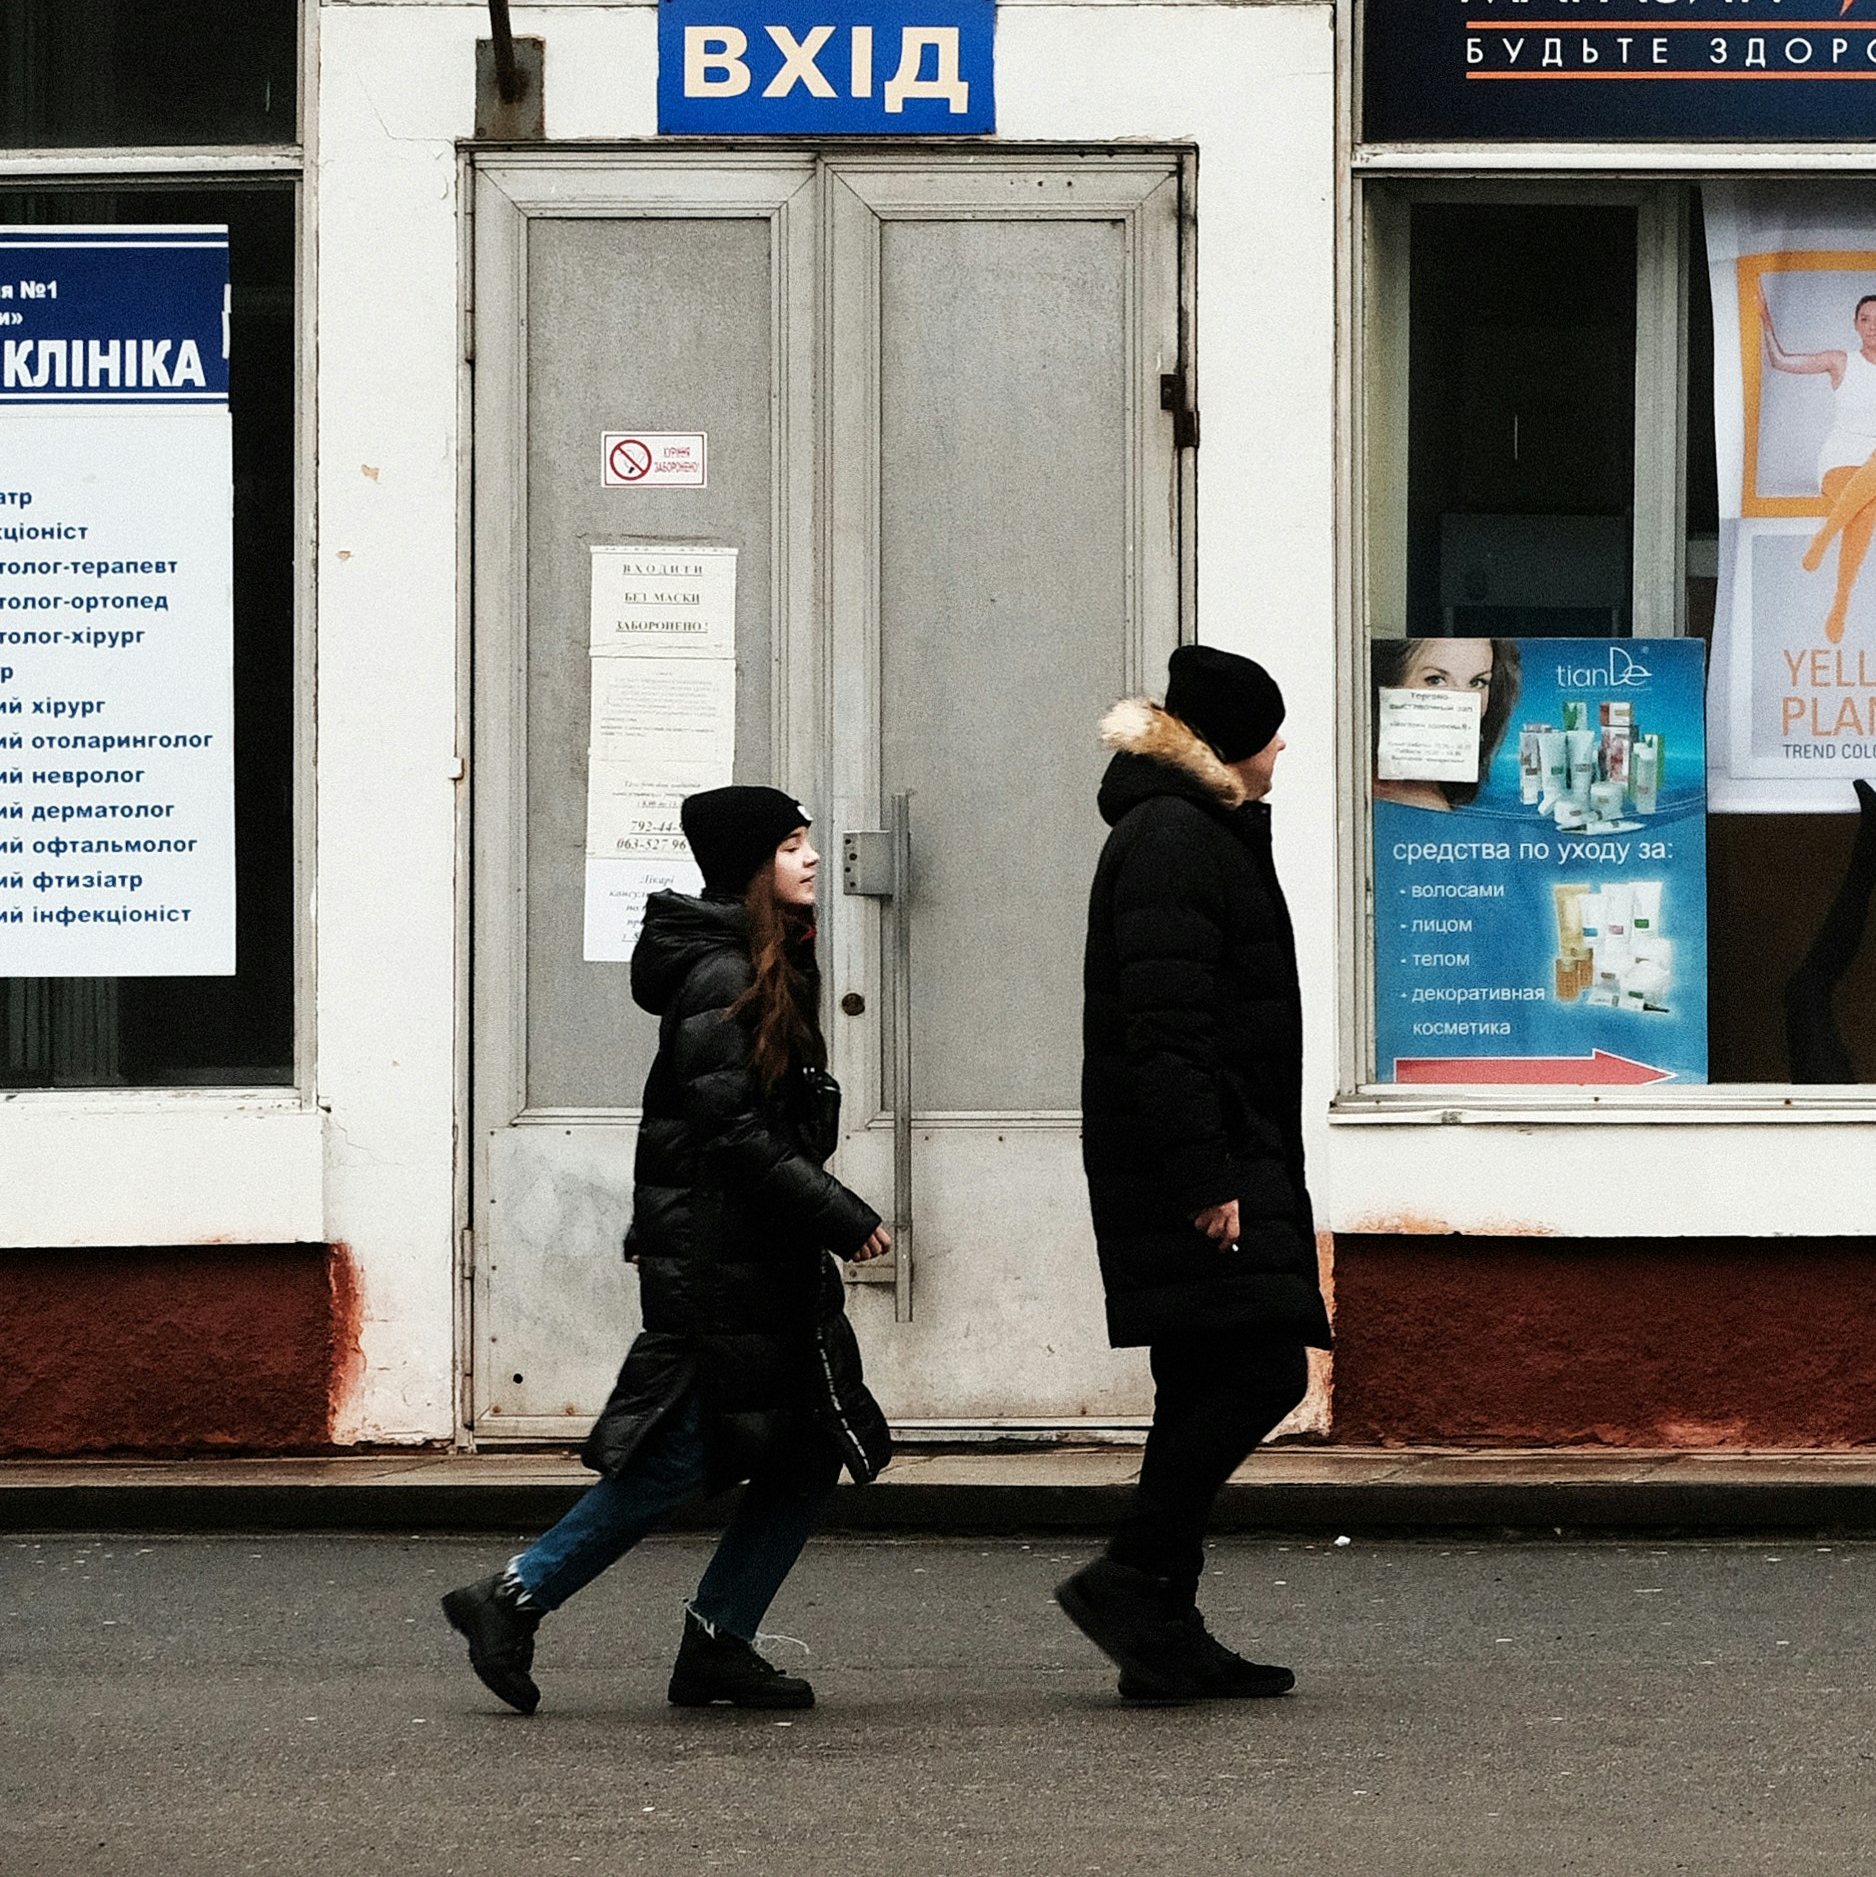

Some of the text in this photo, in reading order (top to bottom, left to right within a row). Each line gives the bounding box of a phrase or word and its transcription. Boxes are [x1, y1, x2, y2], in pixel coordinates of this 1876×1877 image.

[1466, 36, 1670, 70] БУДЬТЕ
[684, 25, 970, 114] ВХІД
[3, 338, 207, 388] КЛІНІКА
[32, 697, 106, 716] хірург
[32, 733, 214, 751] отоларинголог
[1783, 743, 1836, 759] TREND
[32, 769, 145, 787] невролог
[32, 804, 176, 822] дерматолог
[32, 836, 198, 856] офтальмолог
[1392, 842, 1674, 865] средства по уходу за:
[32, 872, 144, 891] фтизіатр
[1412, 884, 1504, 898] волосами
[32, 905, 192, 926] інфекціоніст
[1412, 919, 1473, 935] лицом
[1413, 953, 1470, 967] телом
[1412, 986, 1545, 1002] декоративная
[1413, 1022, 1511, 1035] косметика
